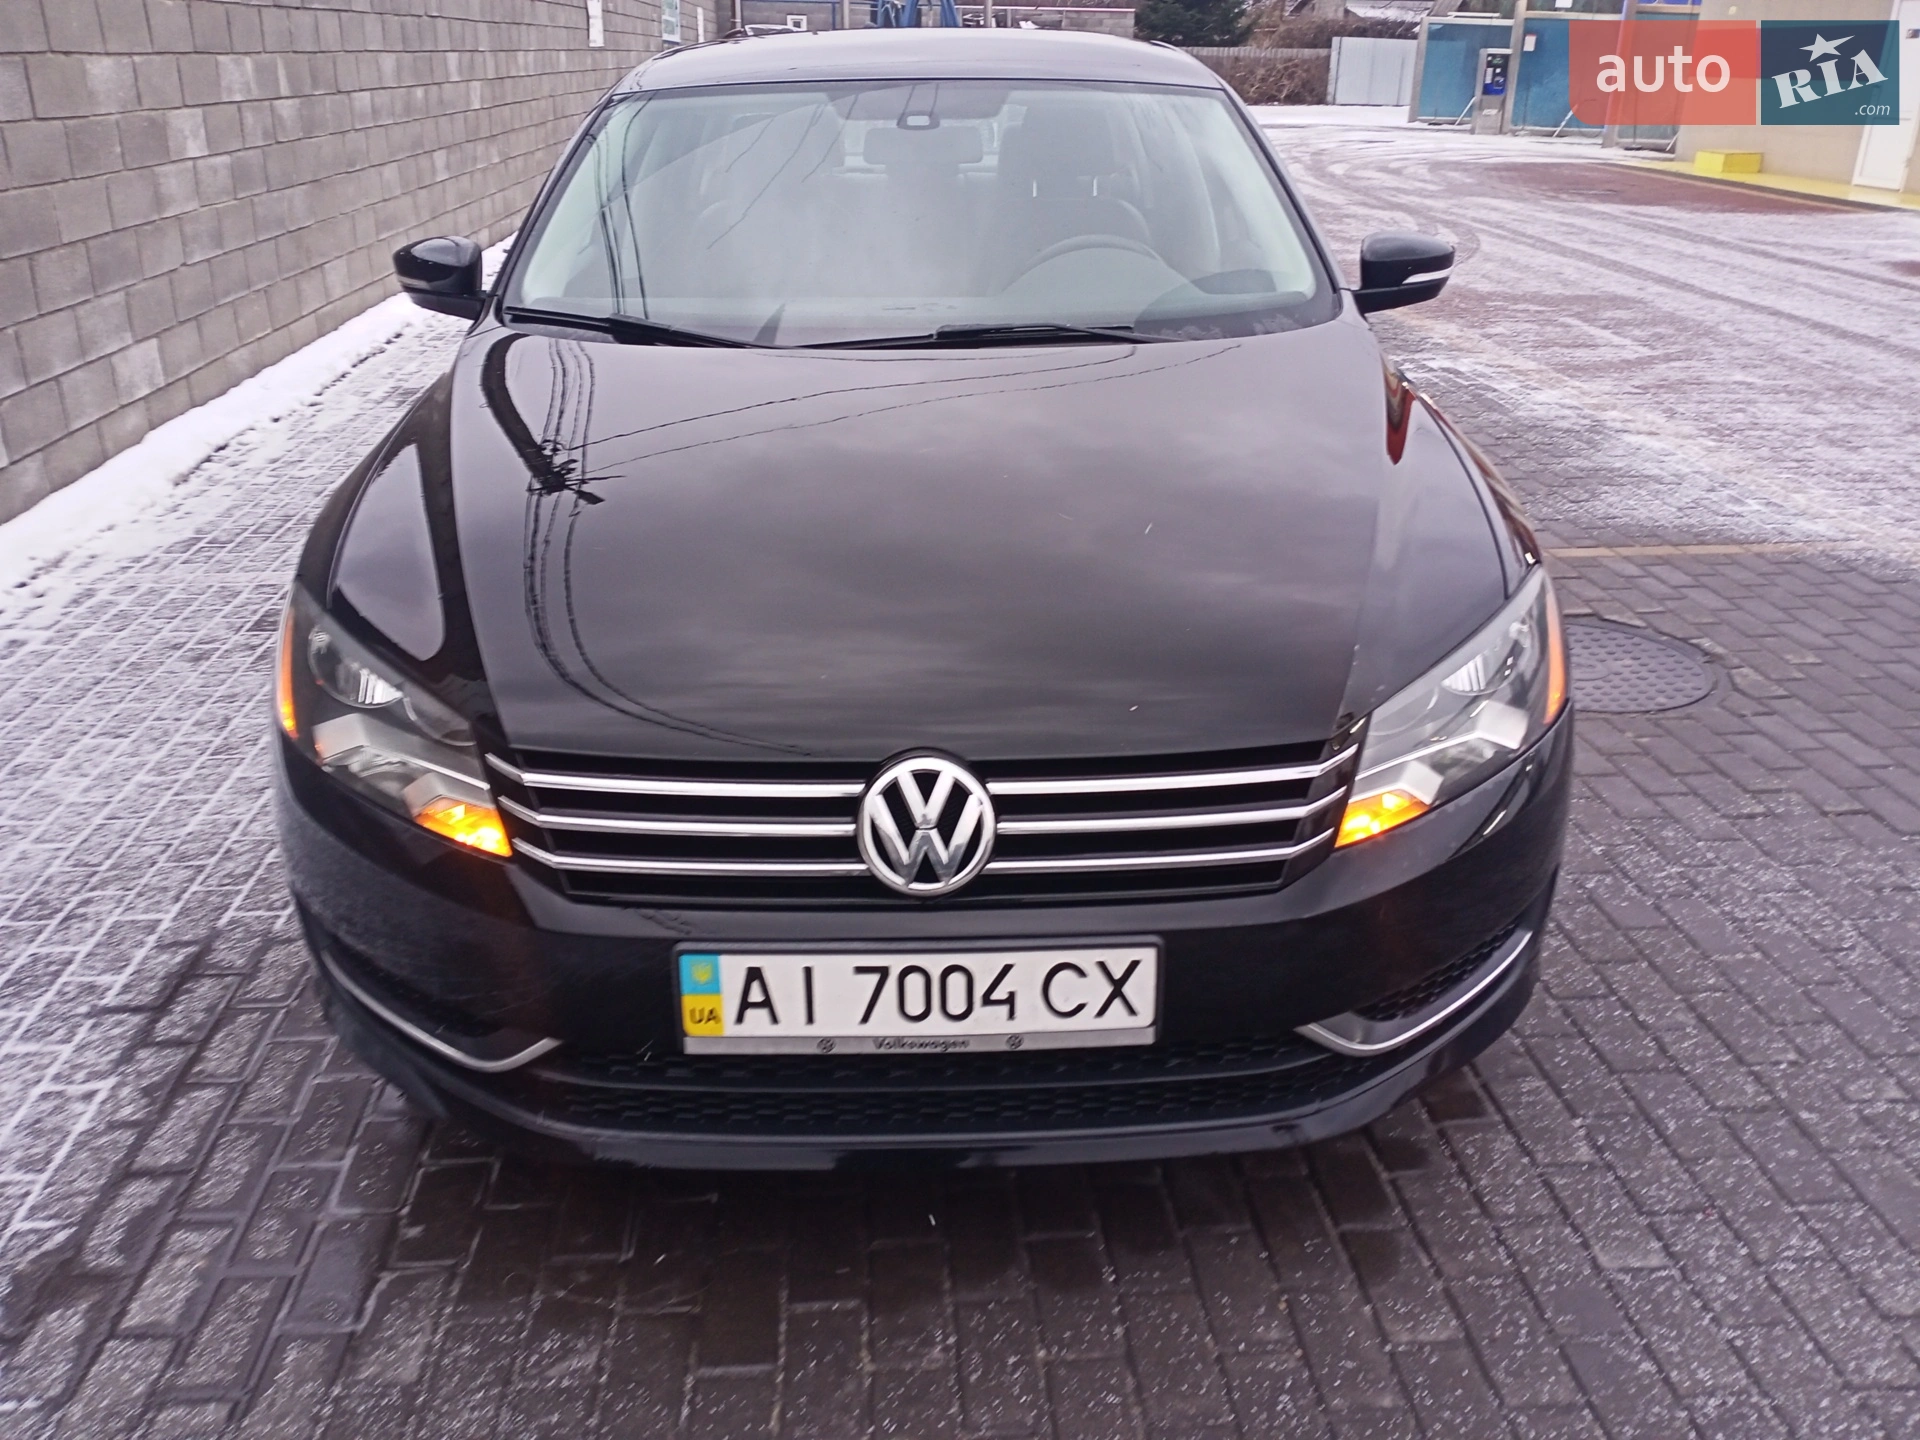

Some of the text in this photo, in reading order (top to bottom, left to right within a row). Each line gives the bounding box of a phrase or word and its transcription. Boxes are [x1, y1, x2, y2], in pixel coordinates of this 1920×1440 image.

[735, 959, 1143, 1025] AI 7004 CX
[689, 1006, 722, 1025] UA
[873, 1036, 970, 1053] Volkswagen
